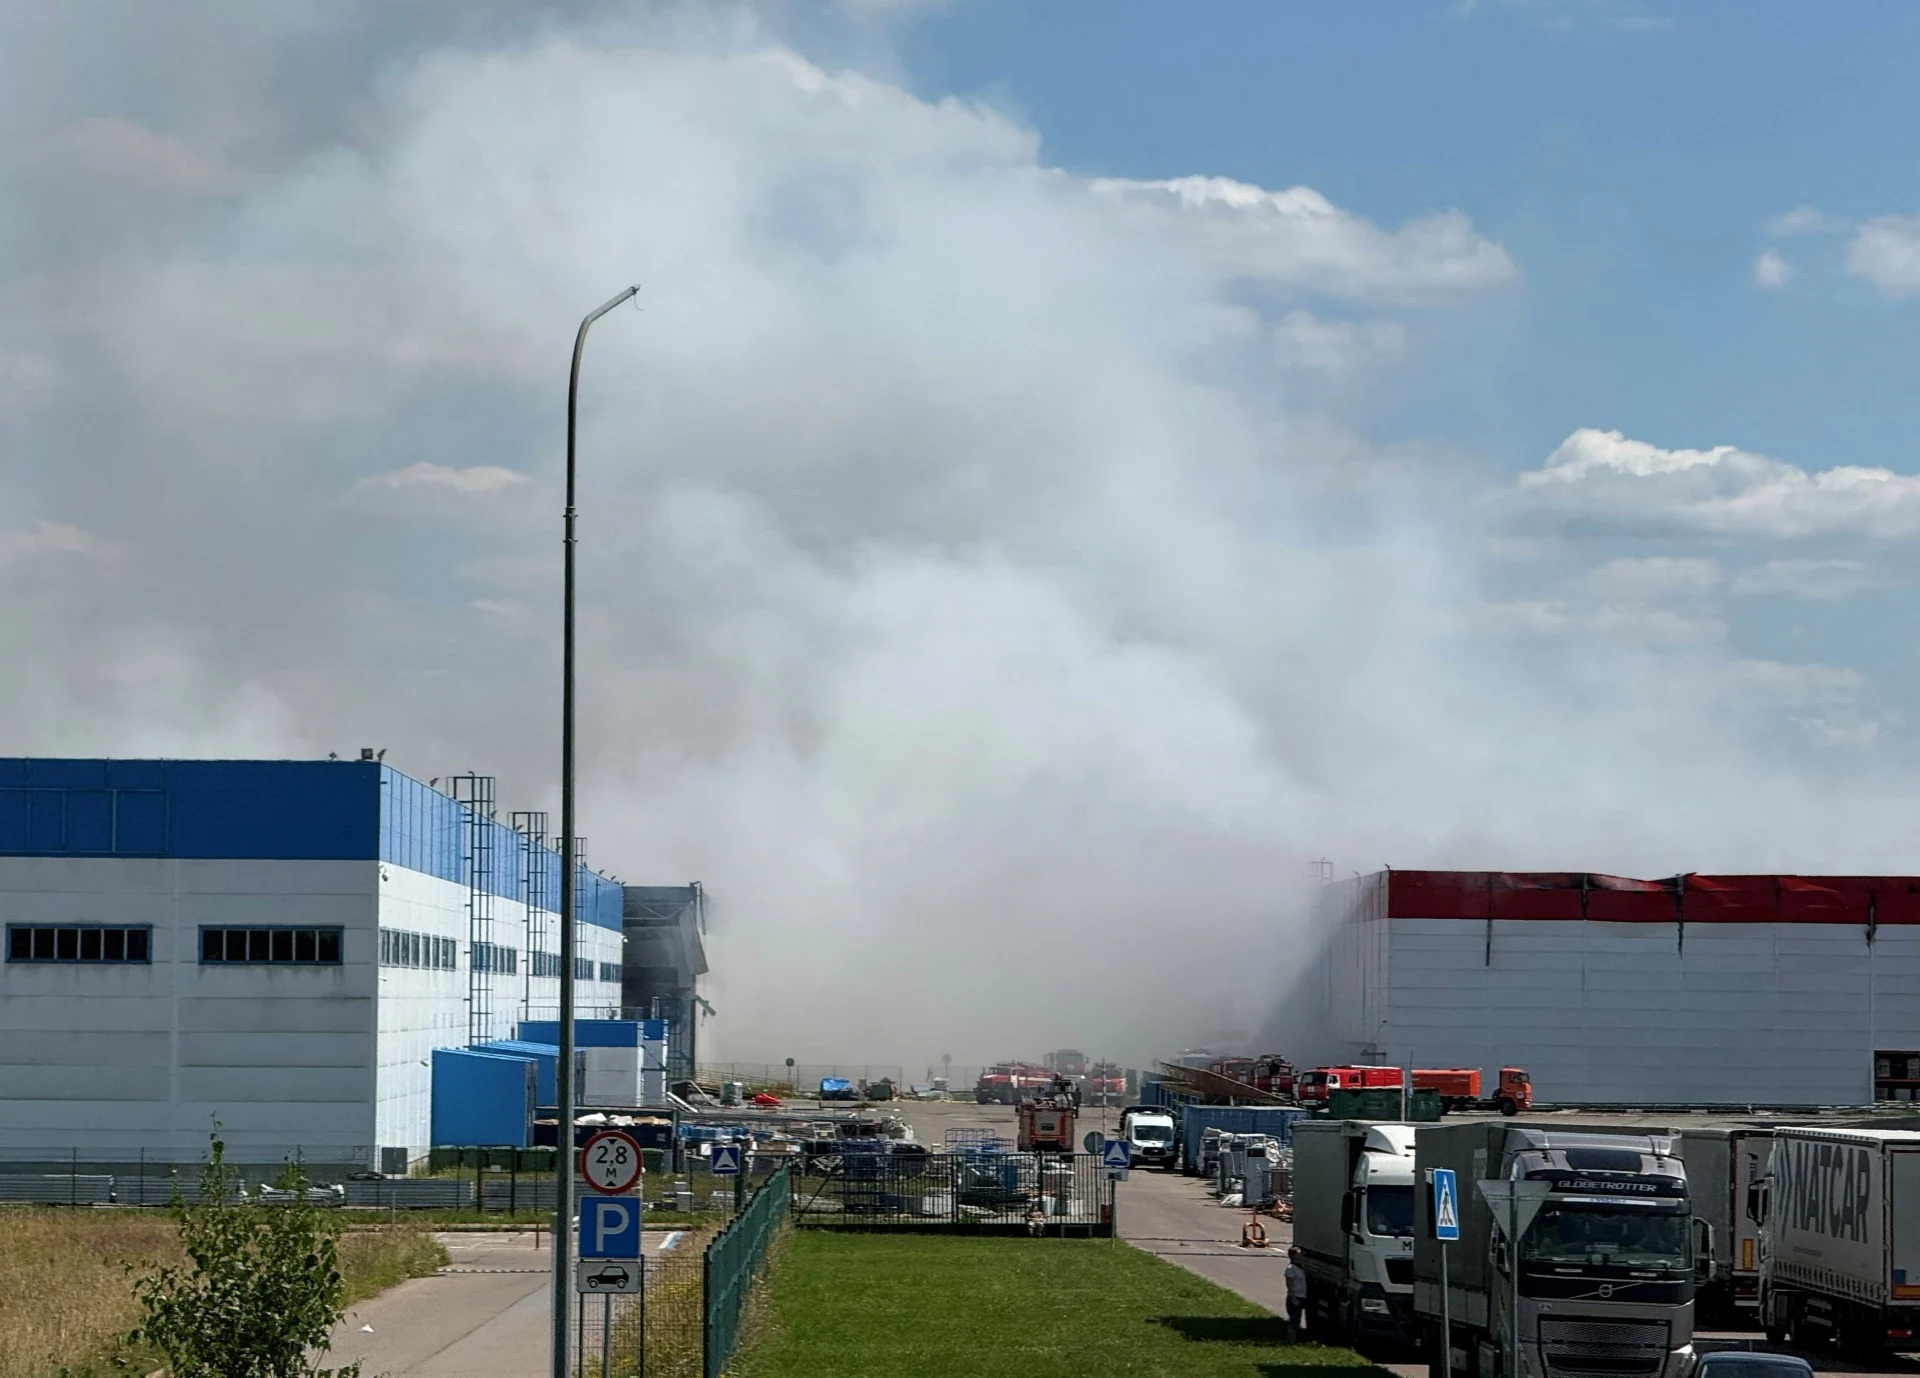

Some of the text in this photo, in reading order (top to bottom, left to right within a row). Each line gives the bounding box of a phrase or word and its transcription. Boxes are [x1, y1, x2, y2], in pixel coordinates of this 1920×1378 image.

[596, 1145, 627, 1165] 2,8
[1558, 1180, 1656, 1192] GLOBETROTTER
[1793, 1142, 1870, 1244] NATCAR
[596, 1203, 629, 1252] P
